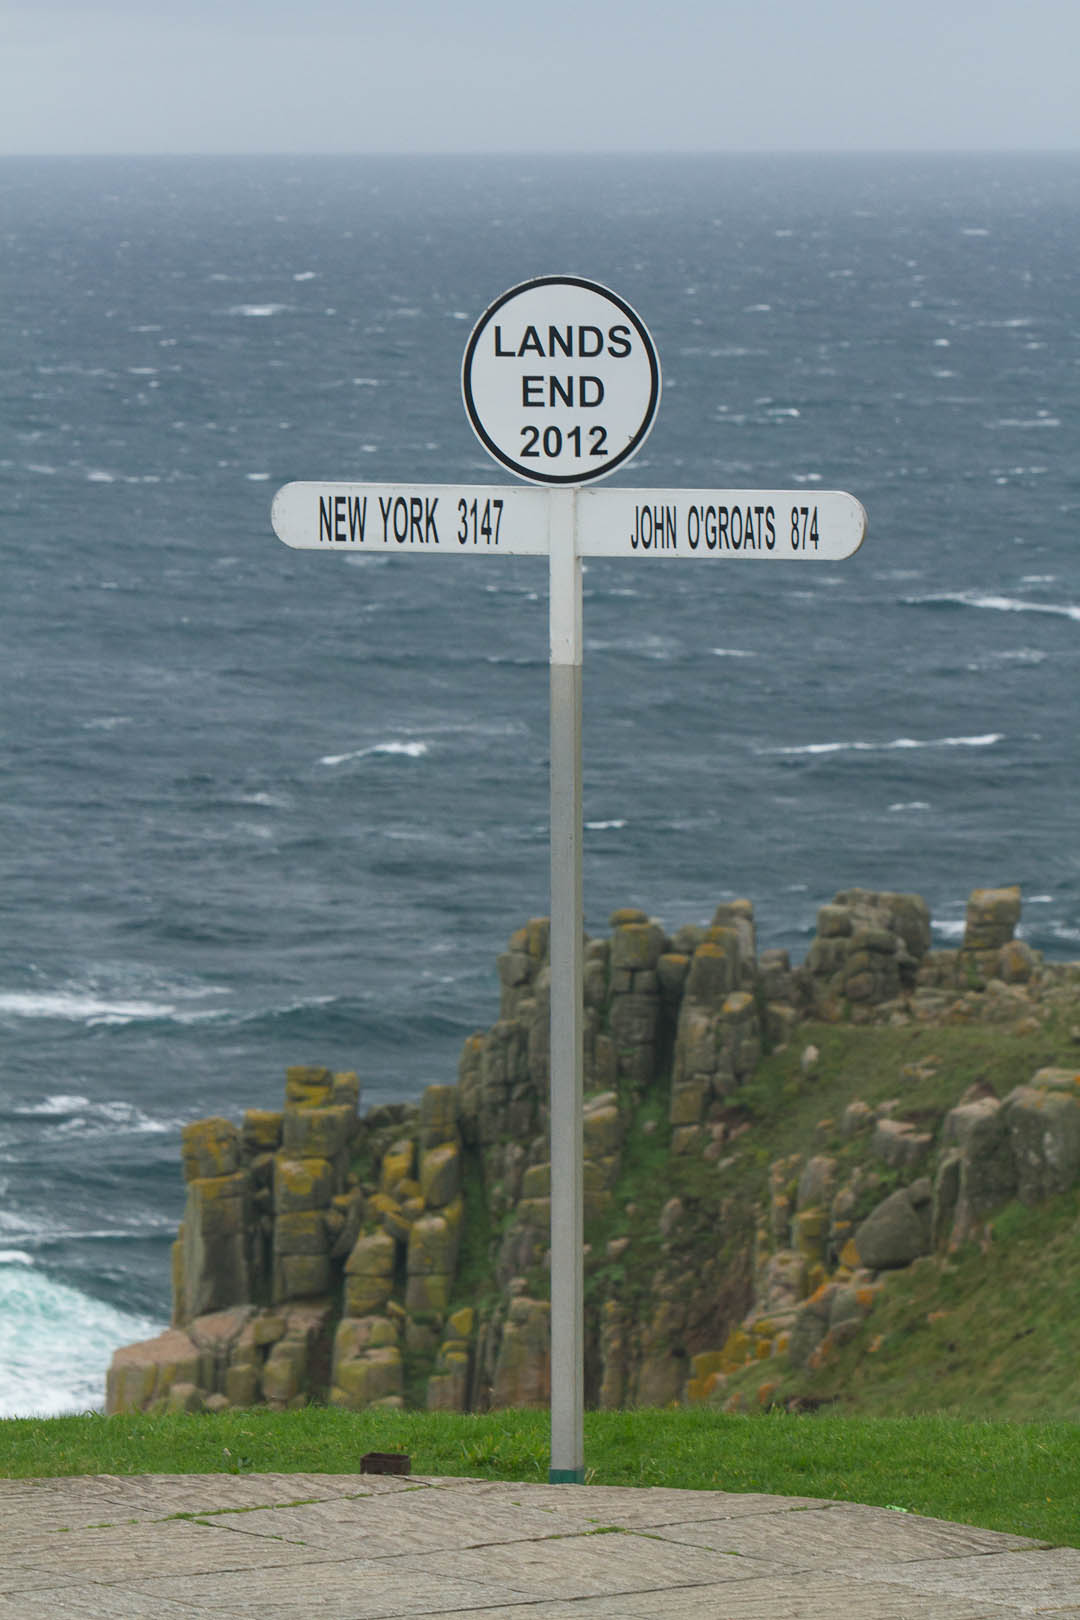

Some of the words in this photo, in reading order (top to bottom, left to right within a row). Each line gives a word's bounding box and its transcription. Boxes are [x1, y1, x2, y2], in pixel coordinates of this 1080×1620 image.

[494, 325, 632, 358] LANDS
[522, 375, 605, 408] END
[519, 425, 609, 458] 2012
[319, 496, 368, 543] NEW
[378, 497, 440, 544] YORK
[457, 498, 504, 545] 3147
[630, 505, 677, 550] JOHN
[687, 505, 776, 551] O'GROATS
[790, 506, 820, 551] 874
